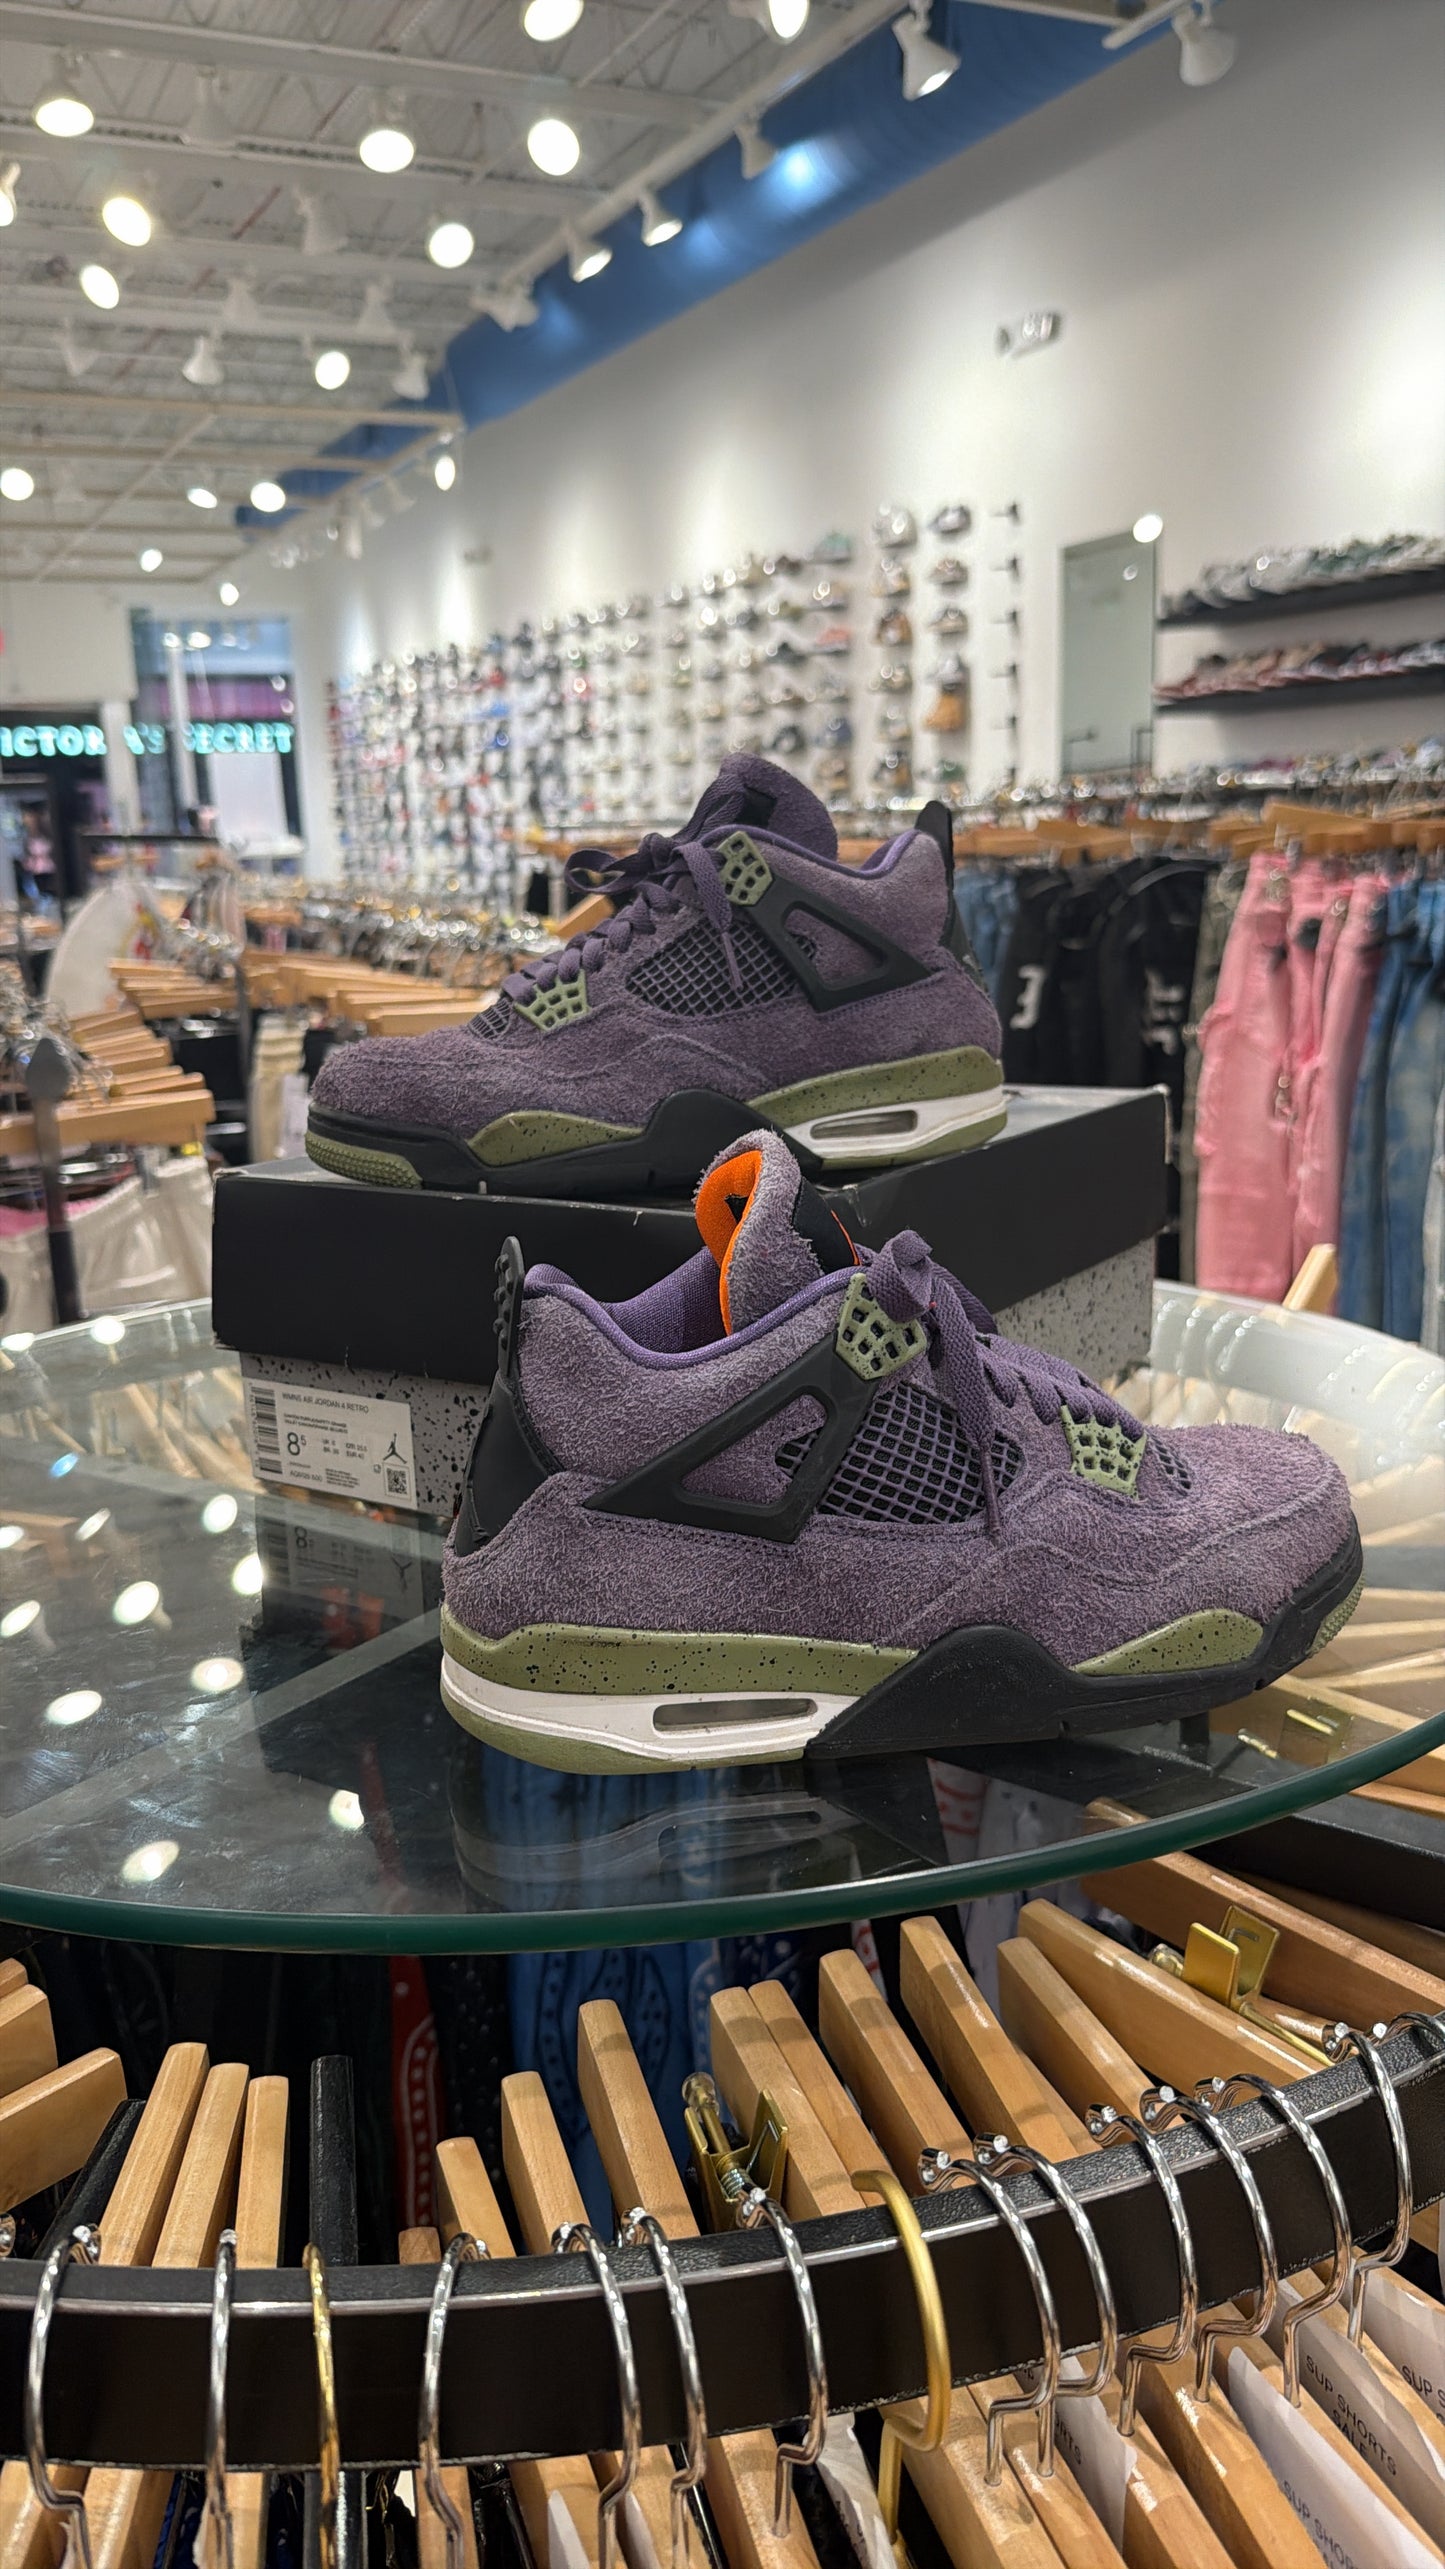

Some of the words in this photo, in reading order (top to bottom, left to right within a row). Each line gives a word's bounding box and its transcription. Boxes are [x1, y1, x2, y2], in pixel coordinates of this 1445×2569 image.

[314, 1397, 340, 1409] JORDAN
[340, 1402, 346, 1410] 4
[346, 1403, 369, 1414] RETRO
[1402, 2365, 1433, 2396] SUP
[1306, 2355, 1334, 2393] SUP
[1338, 2394, 1397, 2476] SHORTS
[1283, 2480, 1310, 2519] SUP
